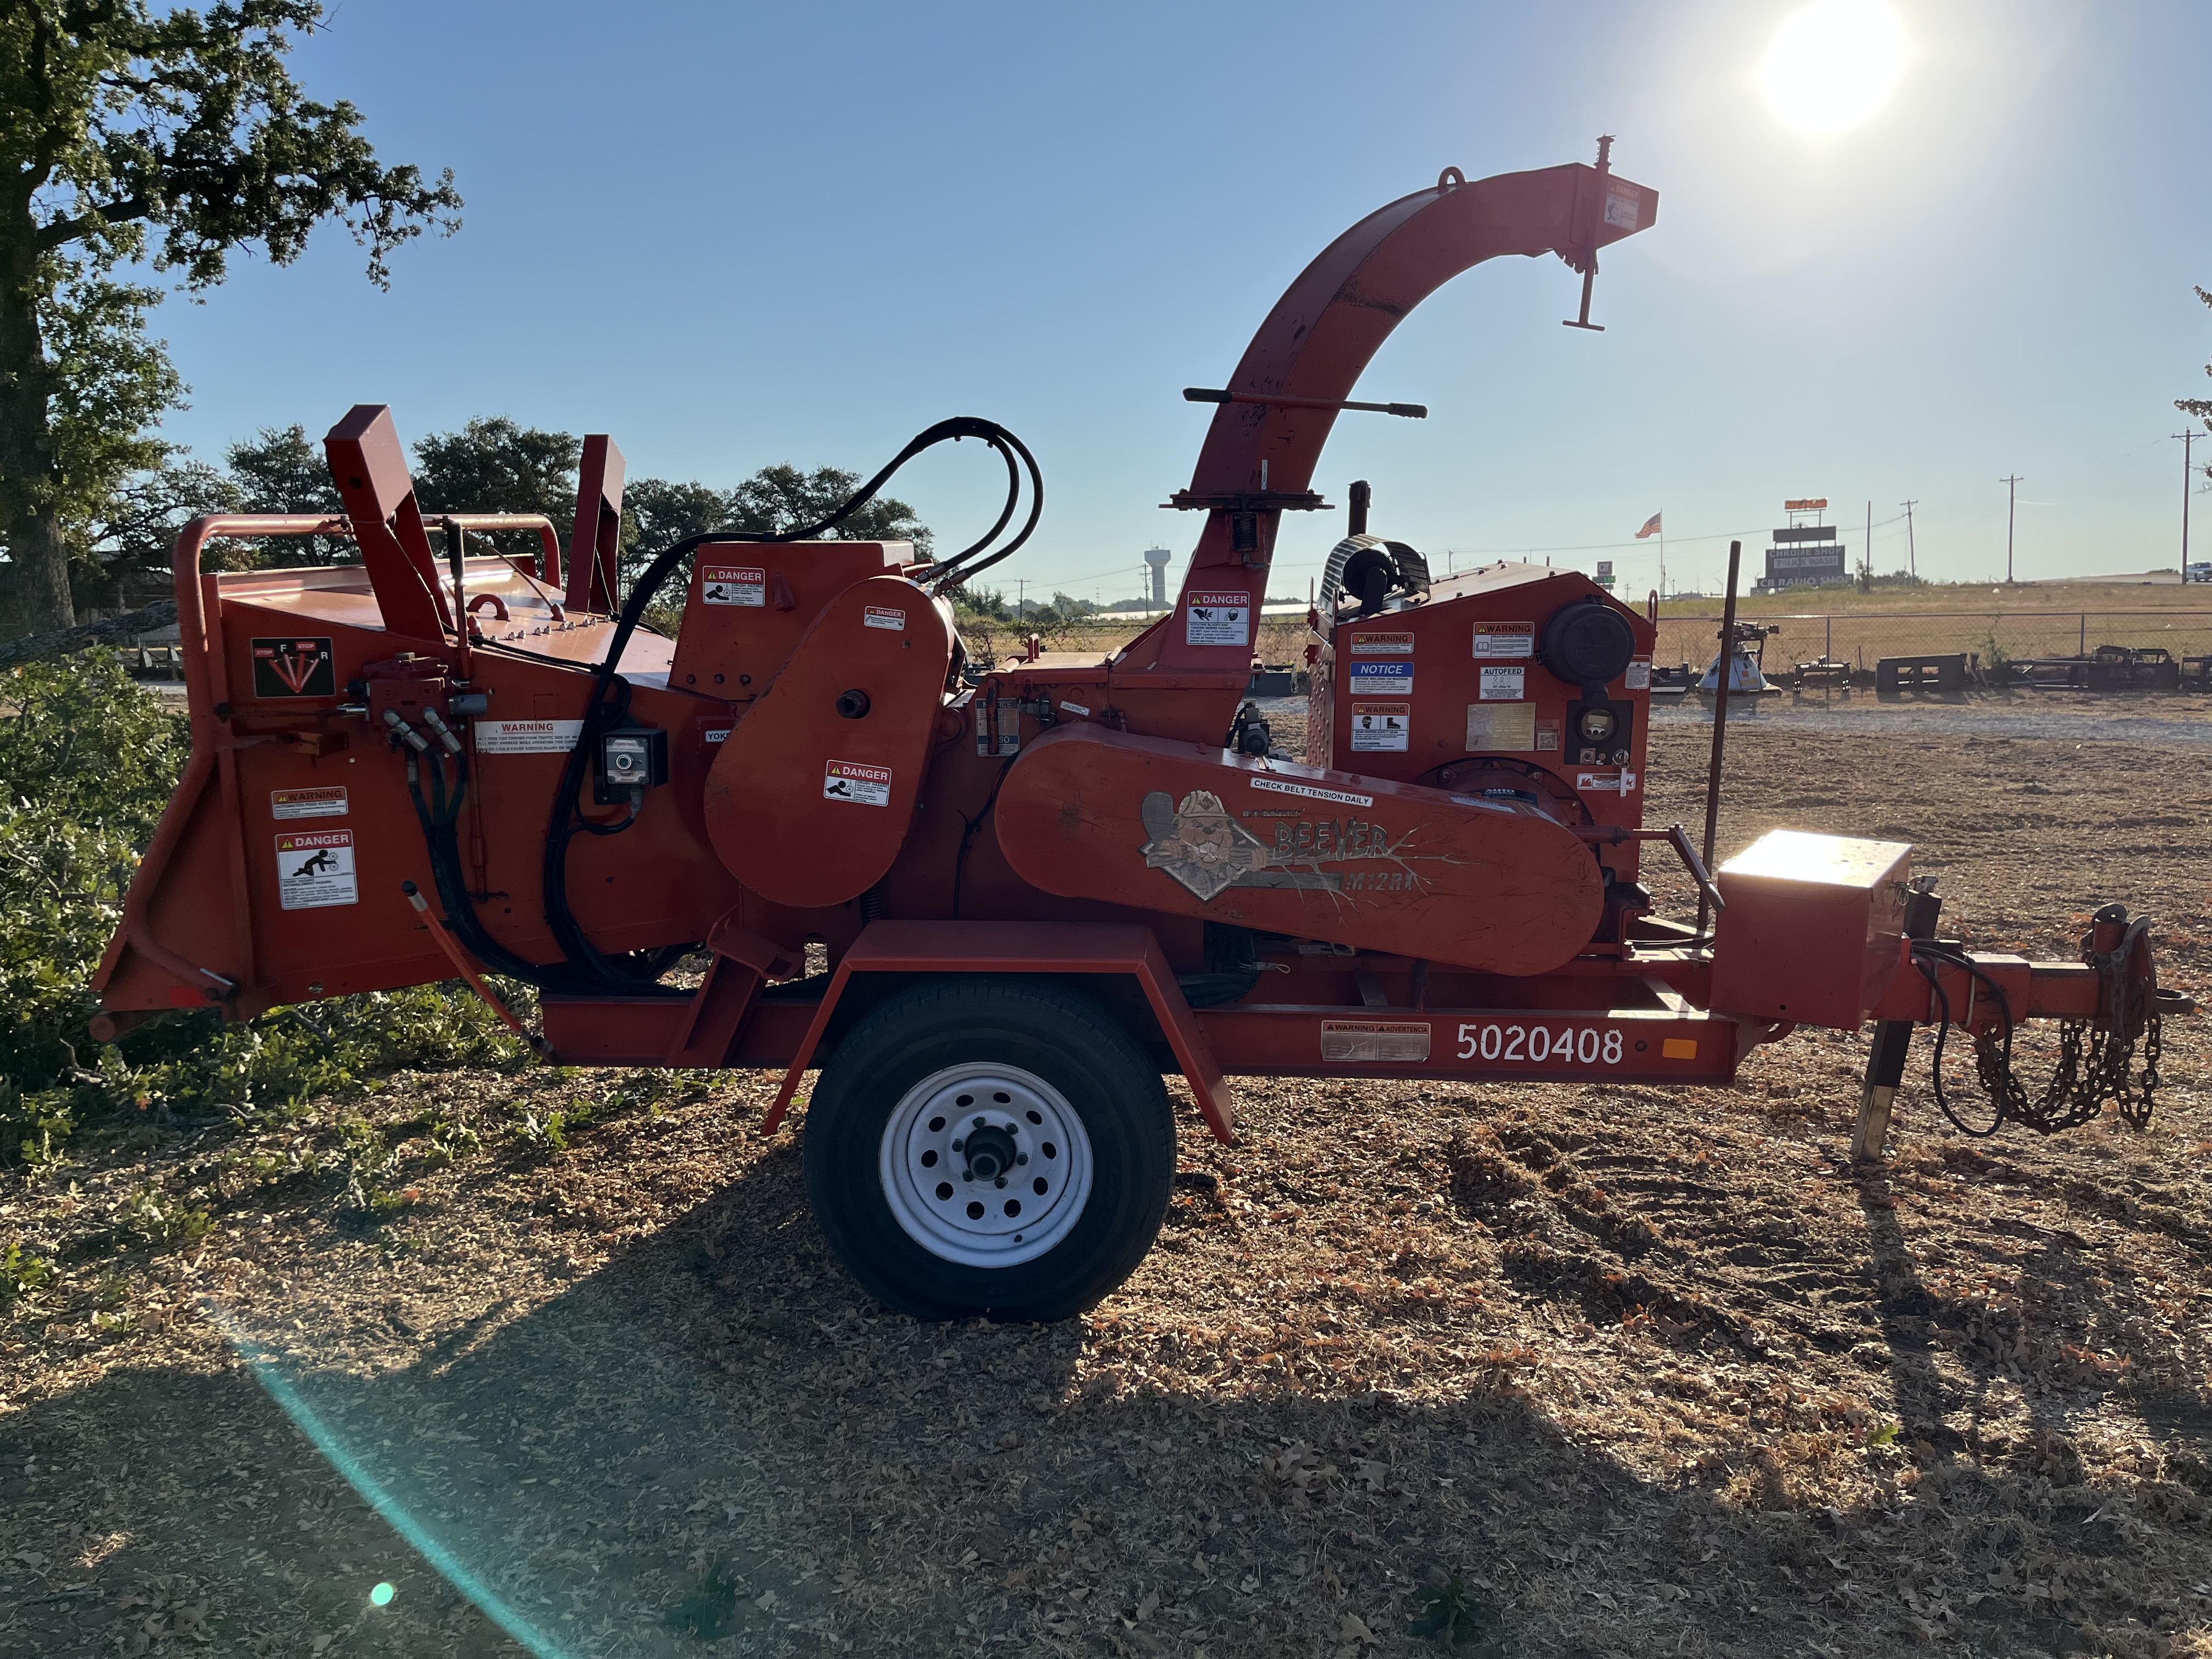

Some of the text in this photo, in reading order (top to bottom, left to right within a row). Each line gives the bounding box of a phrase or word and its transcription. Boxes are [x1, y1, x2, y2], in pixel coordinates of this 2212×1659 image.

[1616, 185, 1638, 199] DANGER
[1769, 548, 1842, 557] CHROME SHOP
[1808, 556, 1837, 566] WASH
[1599, 563, 1610, 572] QT
[718, 571, 761, 581] DANGER
[1759, 575, 1852, 587] CB RADIO SHOP
[1203, 595, 1248, 604] DANGER
[1361, 665, 1403, 674] NOTICE
[501, 723, 554, 731] WARNING
[843, 766, 888, 781] DANGER
[288, 791, 342, 801] WARNING
[1254, 780, 1369, 805] CHECK BELT TENSION DAILY
[295, 834, 349, 847] DANGER
[1273, 817, 1390, 861] BEEVER
[1457, 1024, 1623, 1064] 5020408
